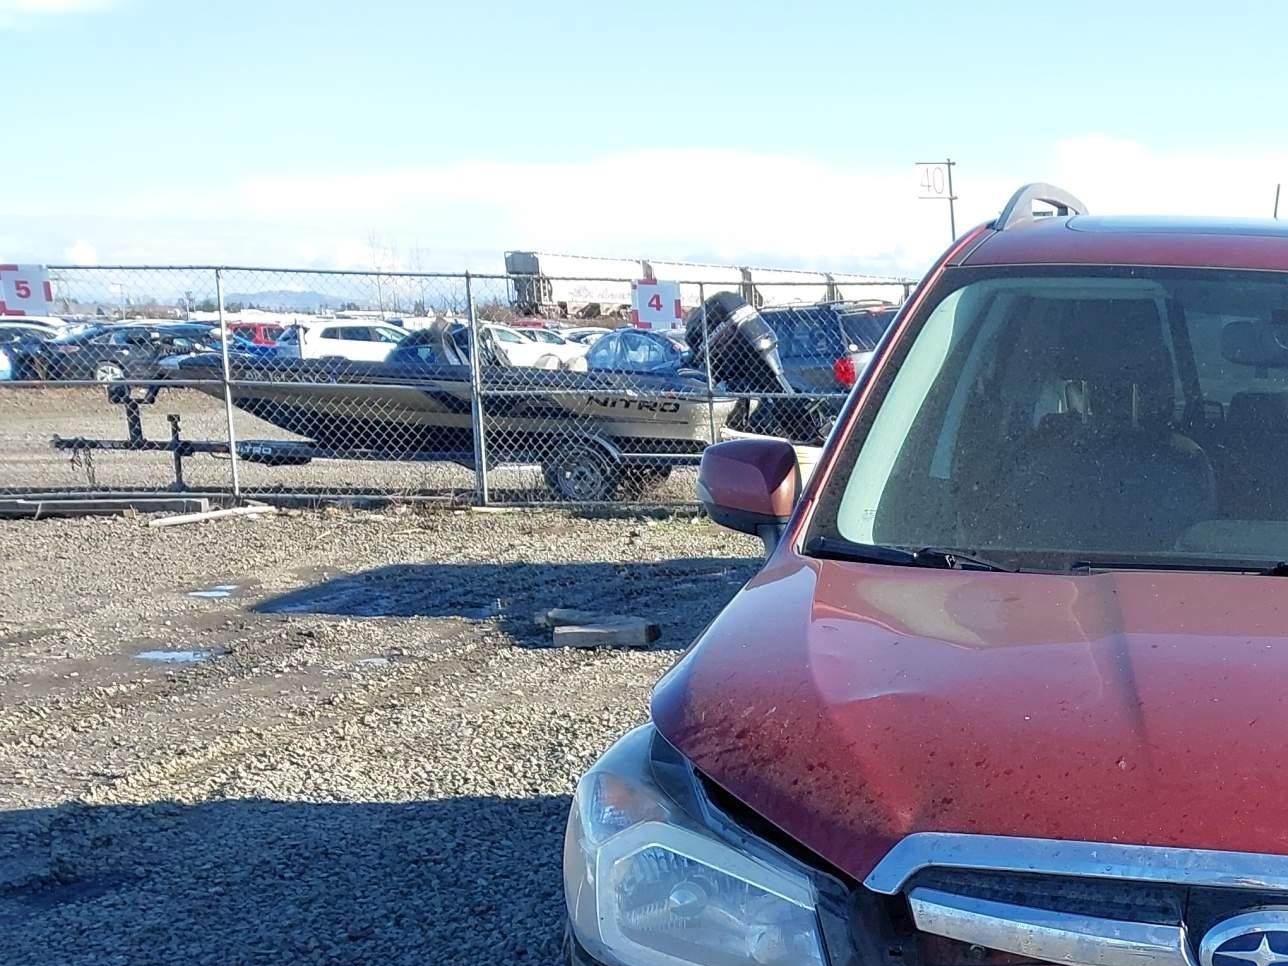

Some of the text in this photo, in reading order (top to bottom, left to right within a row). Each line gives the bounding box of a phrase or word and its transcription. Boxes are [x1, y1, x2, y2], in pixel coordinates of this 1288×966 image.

[15, 280, 31, 298] 5
[648, 294, 663, 311] 4
[586, 395, 680, 413] NITRO
